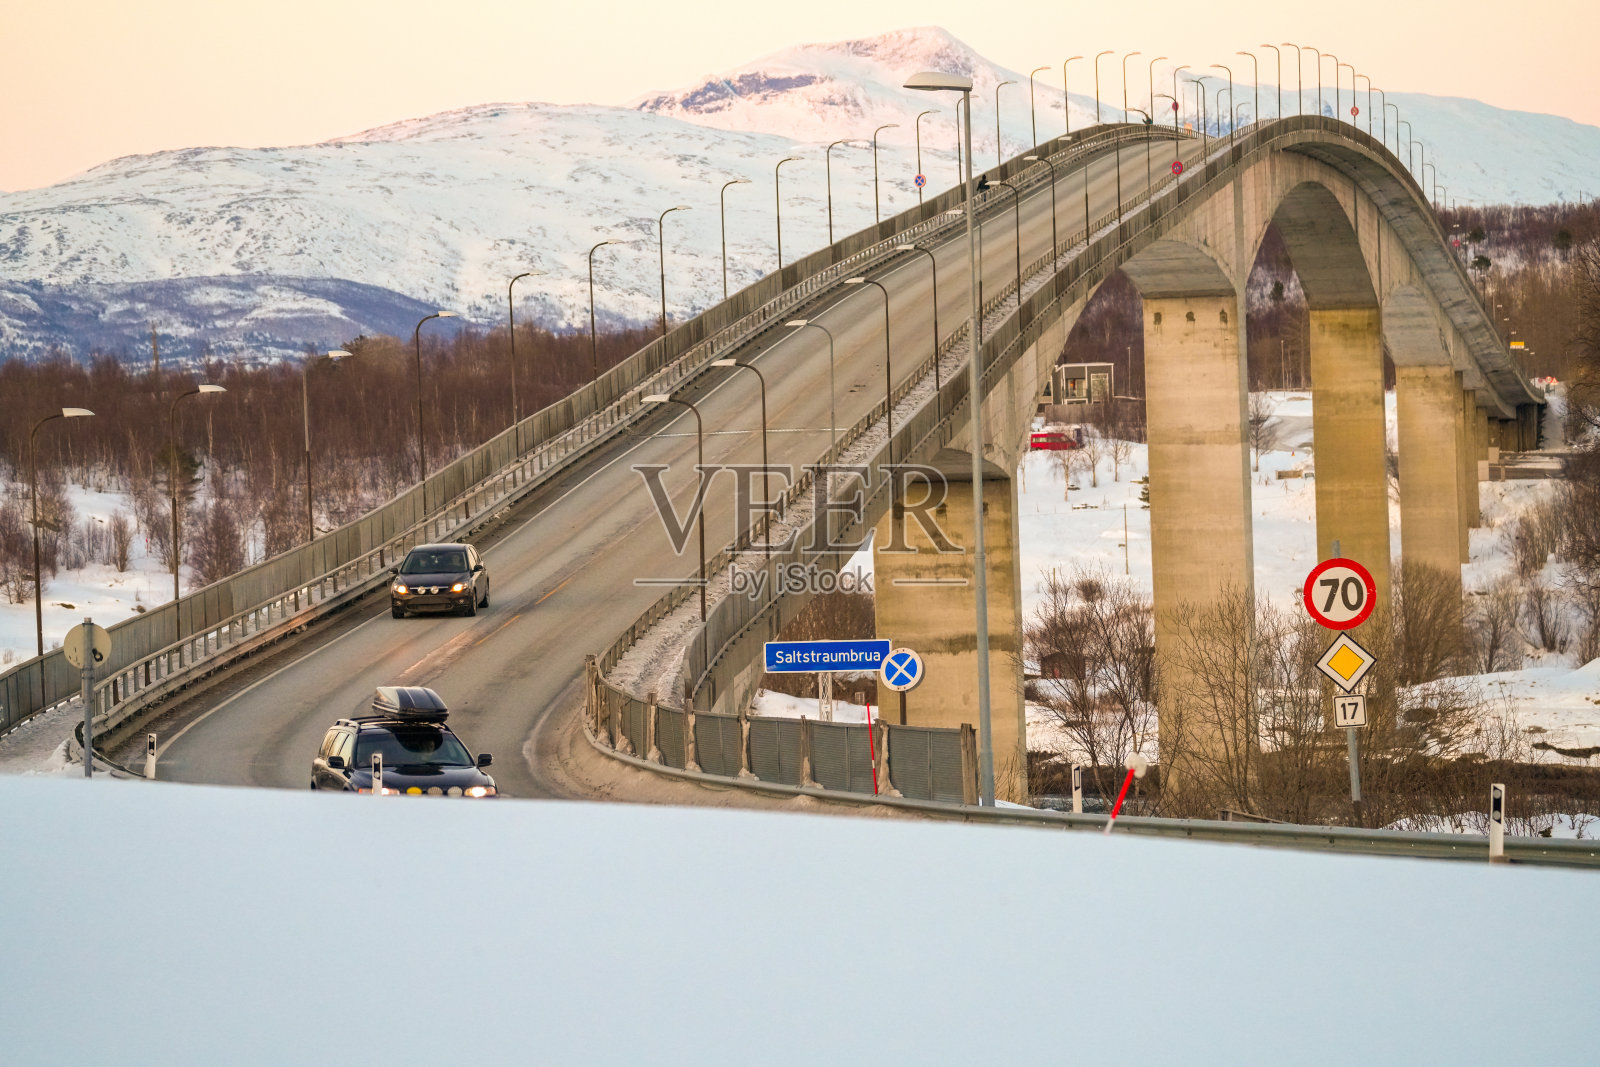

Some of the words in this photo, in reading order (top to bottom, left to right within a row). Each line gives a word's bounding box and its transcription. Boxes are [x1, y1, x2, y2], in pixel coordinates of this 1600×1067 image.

[1320, 577, 1364, 612] 70
[775, 649, 881, 664] Saltstraumbrua
[1340, 702, 1359, 719] 17
